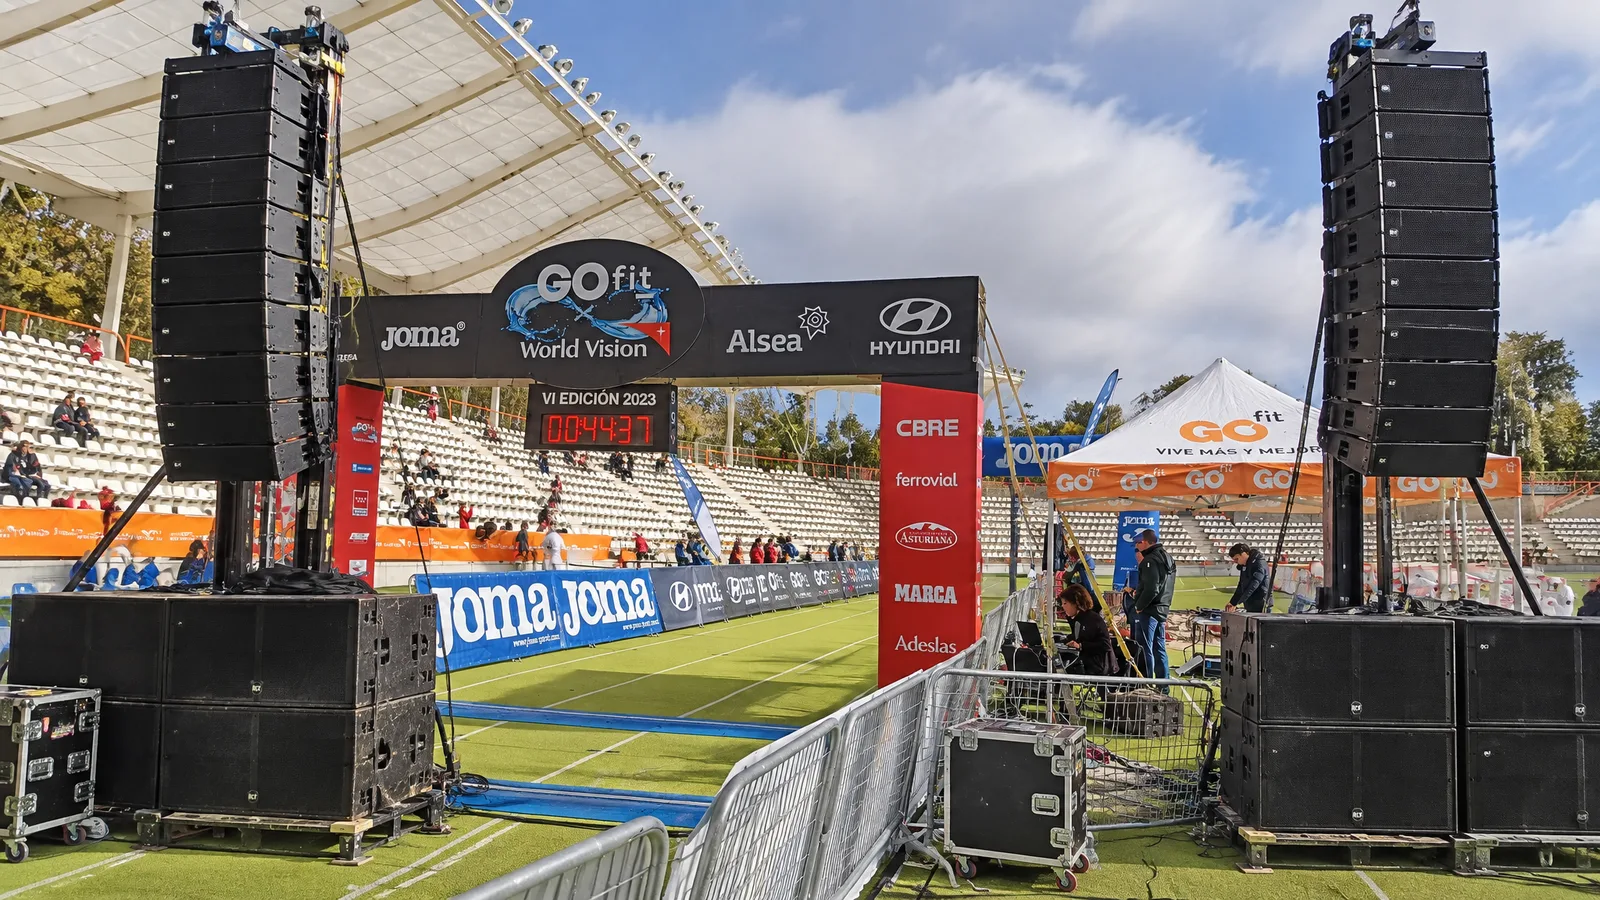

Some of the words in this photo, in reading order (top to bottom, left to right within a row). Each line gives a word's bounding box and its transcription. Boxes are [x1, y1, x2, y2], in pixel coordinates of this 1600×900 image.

[520, 339, 579, 360] World
[584, 339, 648, 358] Vision
[726, 329, 803, 353] Alsea
[870, 339, 960, 356] HYUNDAI
[542, 392, 556, 405] VI
[559, 389, 619, 406] EDICIÓN
[622, 392, 657, 406] 2023
[547, 414, 650, 444] 00:44:37
[896, 419, 960, 437] CBRE
[1156, 447, 1193, 456] VIVE
[1199, 446, 1237, 456] MÁS
[1243, 447, 1253, 456] Y
[896, 472, 958, 487] ferrovial
[894, 583, 957, 604] MARCA
[895, 634, 957, 654] Adeslas
